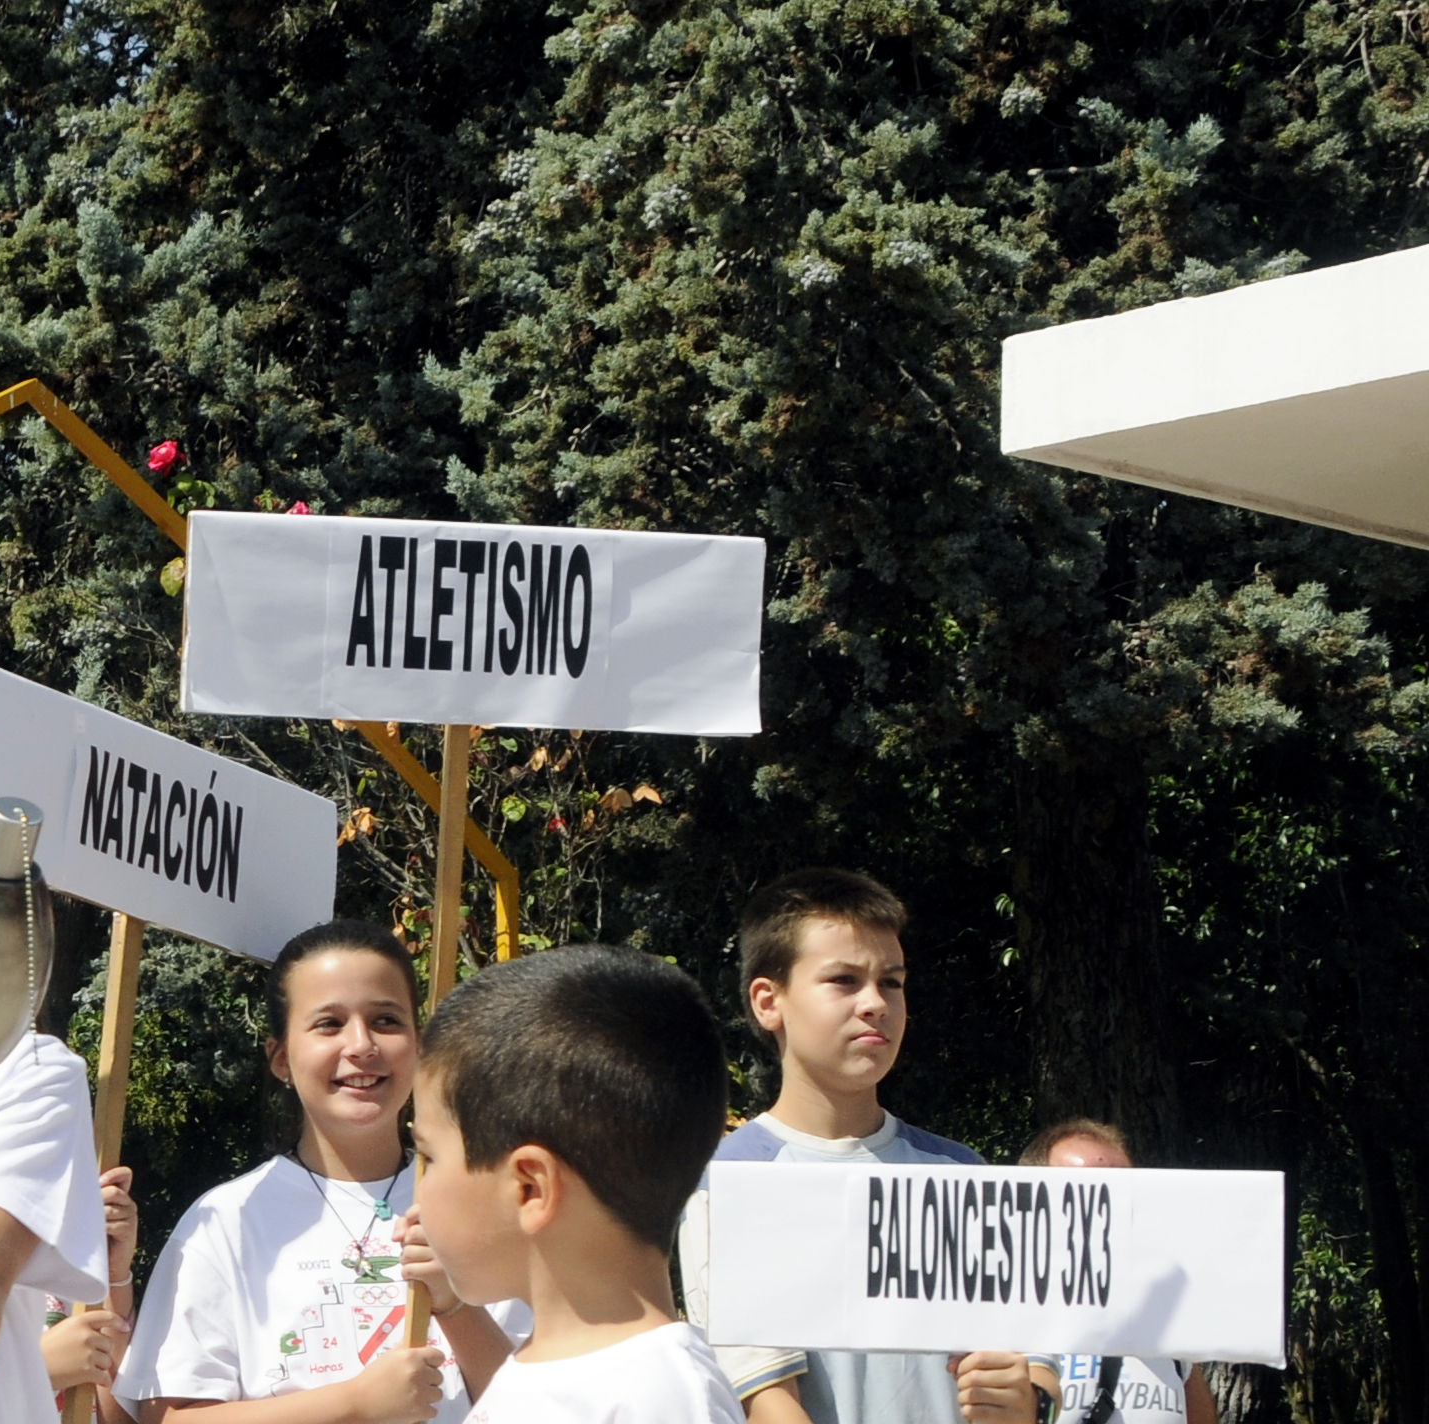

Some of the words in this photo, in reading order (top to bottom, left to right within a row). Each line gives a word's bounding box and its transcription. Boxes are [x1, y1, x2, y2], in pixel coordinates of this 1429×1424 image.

[345, 534, 593, 679] ATLETISMO
[79, 745, 245, 905] NATACIÓN
[867, 1177, 1051, 1305] BALONCESTO
[1061, 1182, 1111, 1307] 3X3
[309, 1362, 344, 1375] Horas
[323, 1337, 338, 1349] 24
[1061, 1382, 1183, 1415] OLYBALL
